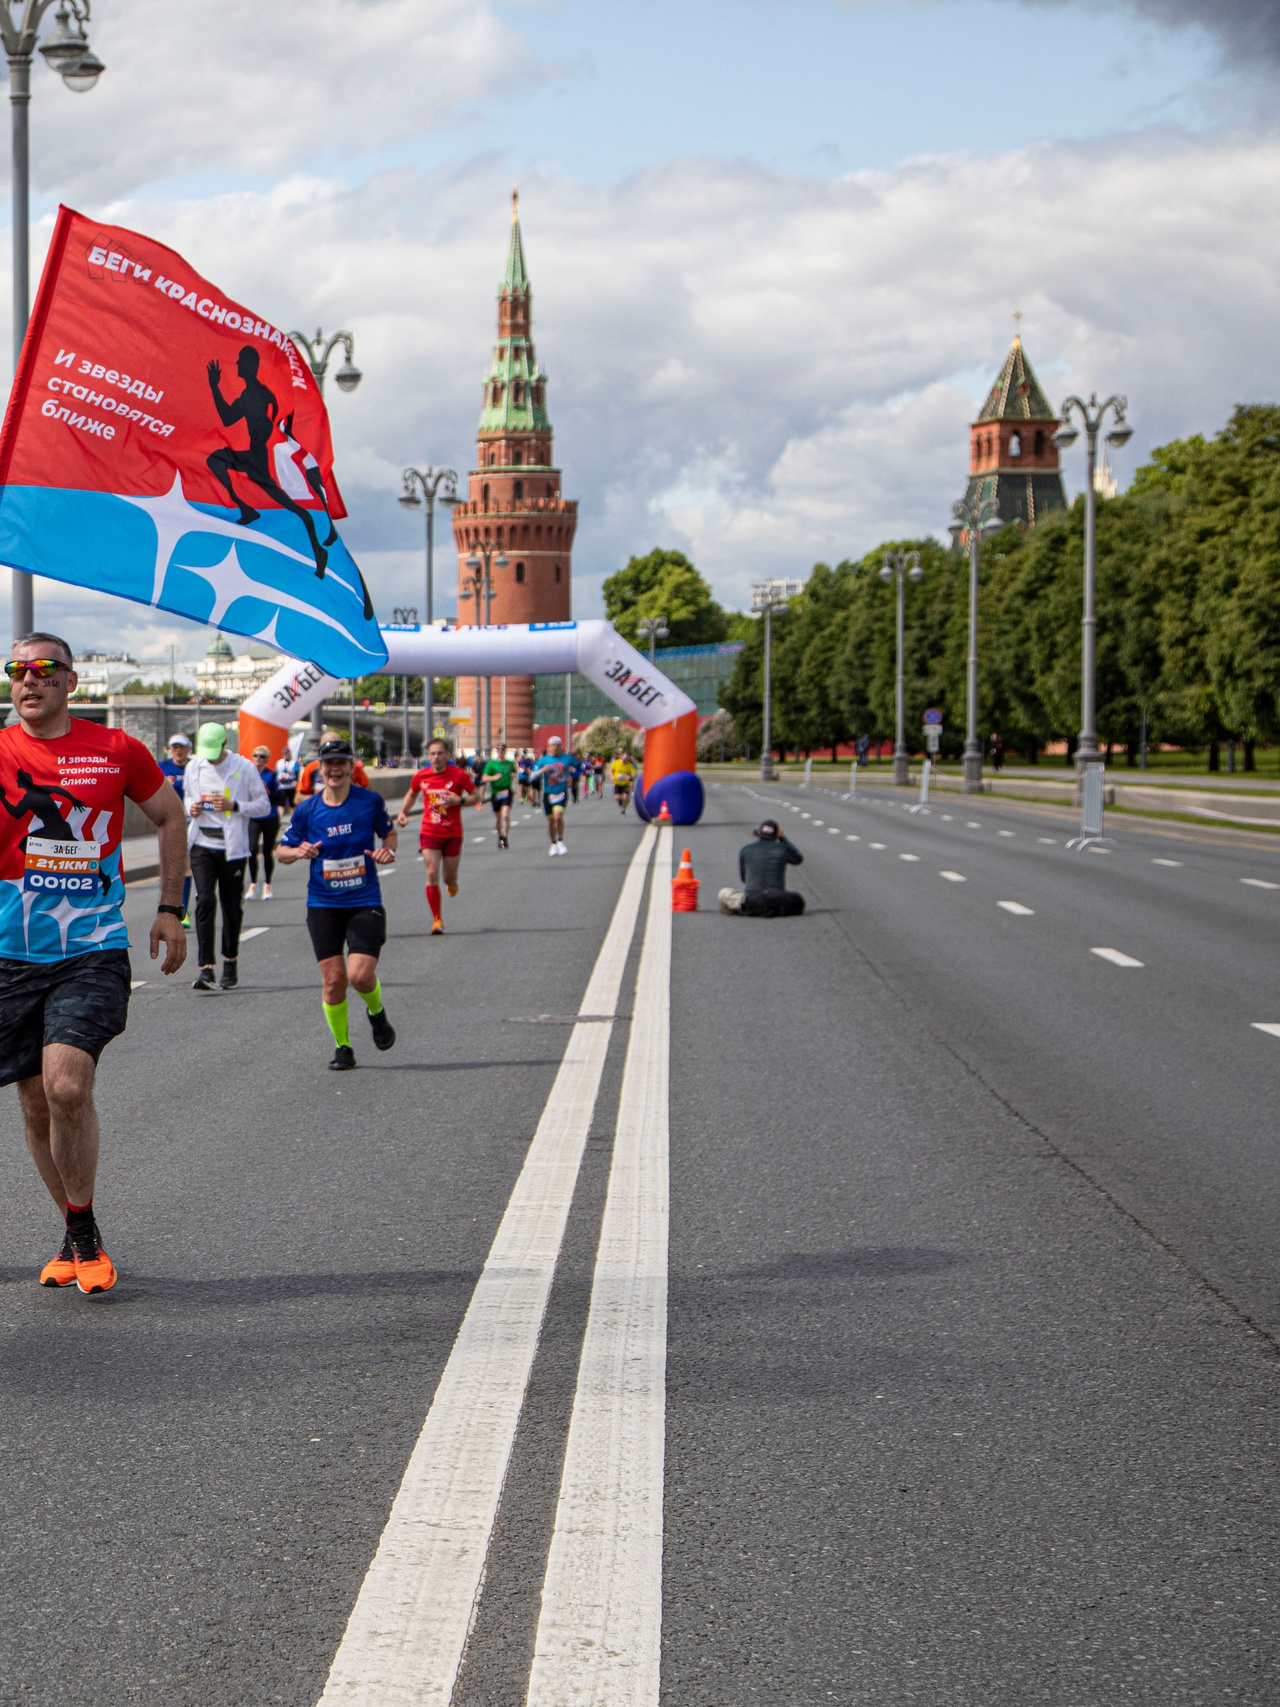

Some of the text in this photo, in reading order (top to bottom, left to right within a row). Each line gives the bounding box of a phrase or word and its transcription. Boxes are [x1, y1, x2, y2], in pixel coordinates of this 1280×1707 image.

[88, 246, 152, 282] БЕГИ
[53, 349, 164, 404] И звезды
[41, 399, 116, 440] ближе
[47, 377, 176, 437] становятся
[57, 755, 108, 765] И звезды
[59, 766, 121, 775] становятся
[61, 777, 98, 786] ближе
[29, 874, 93, 890] 00102
